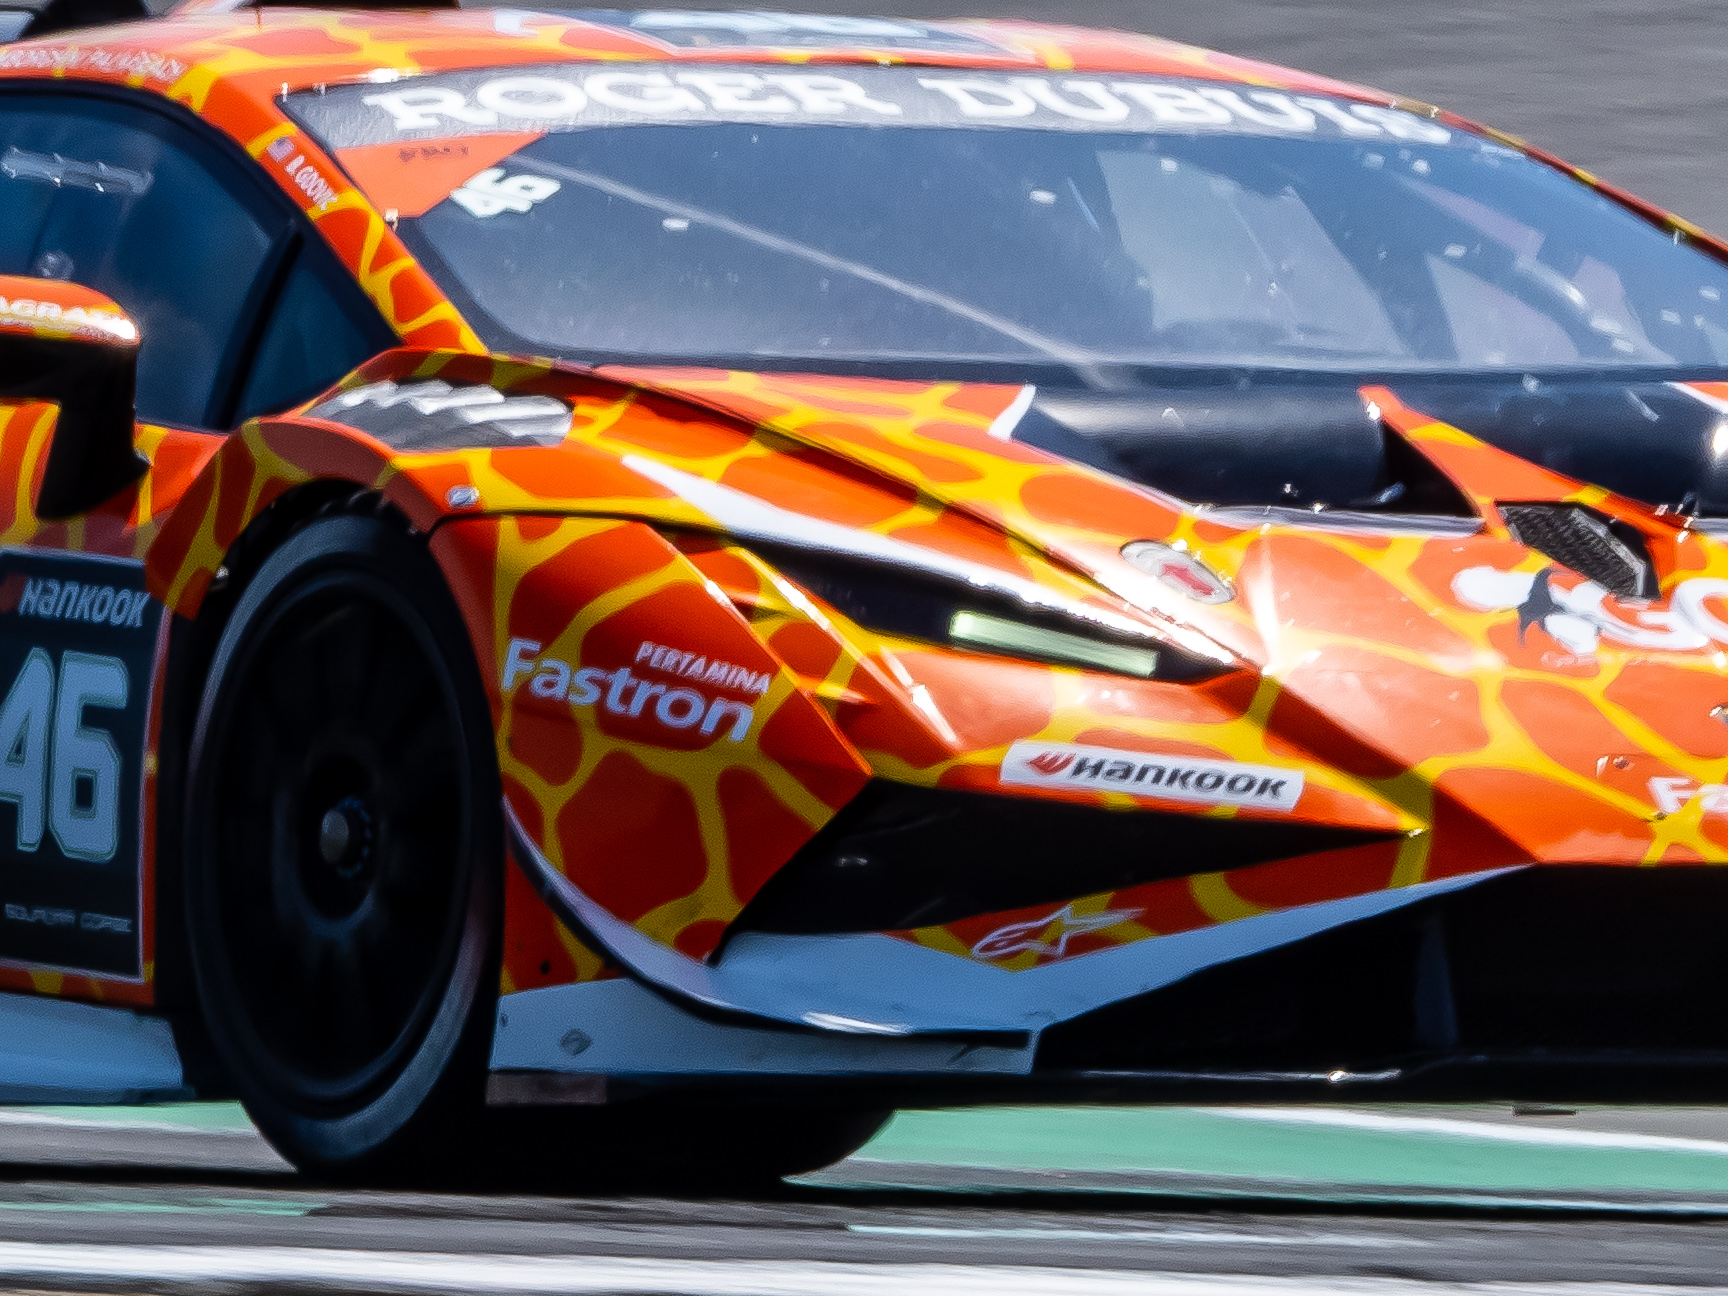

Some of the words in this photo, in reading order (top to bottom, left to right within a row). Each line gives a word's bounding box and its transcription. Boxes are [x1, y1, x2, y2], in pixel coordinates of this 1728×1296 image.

[363, 70, 902, 131] ROGER
[918, 76, 1452, 146] DUBUIS
[501, 636, 757, 743] Fastron
[635, 641, 772, 696] PERTAMINA
